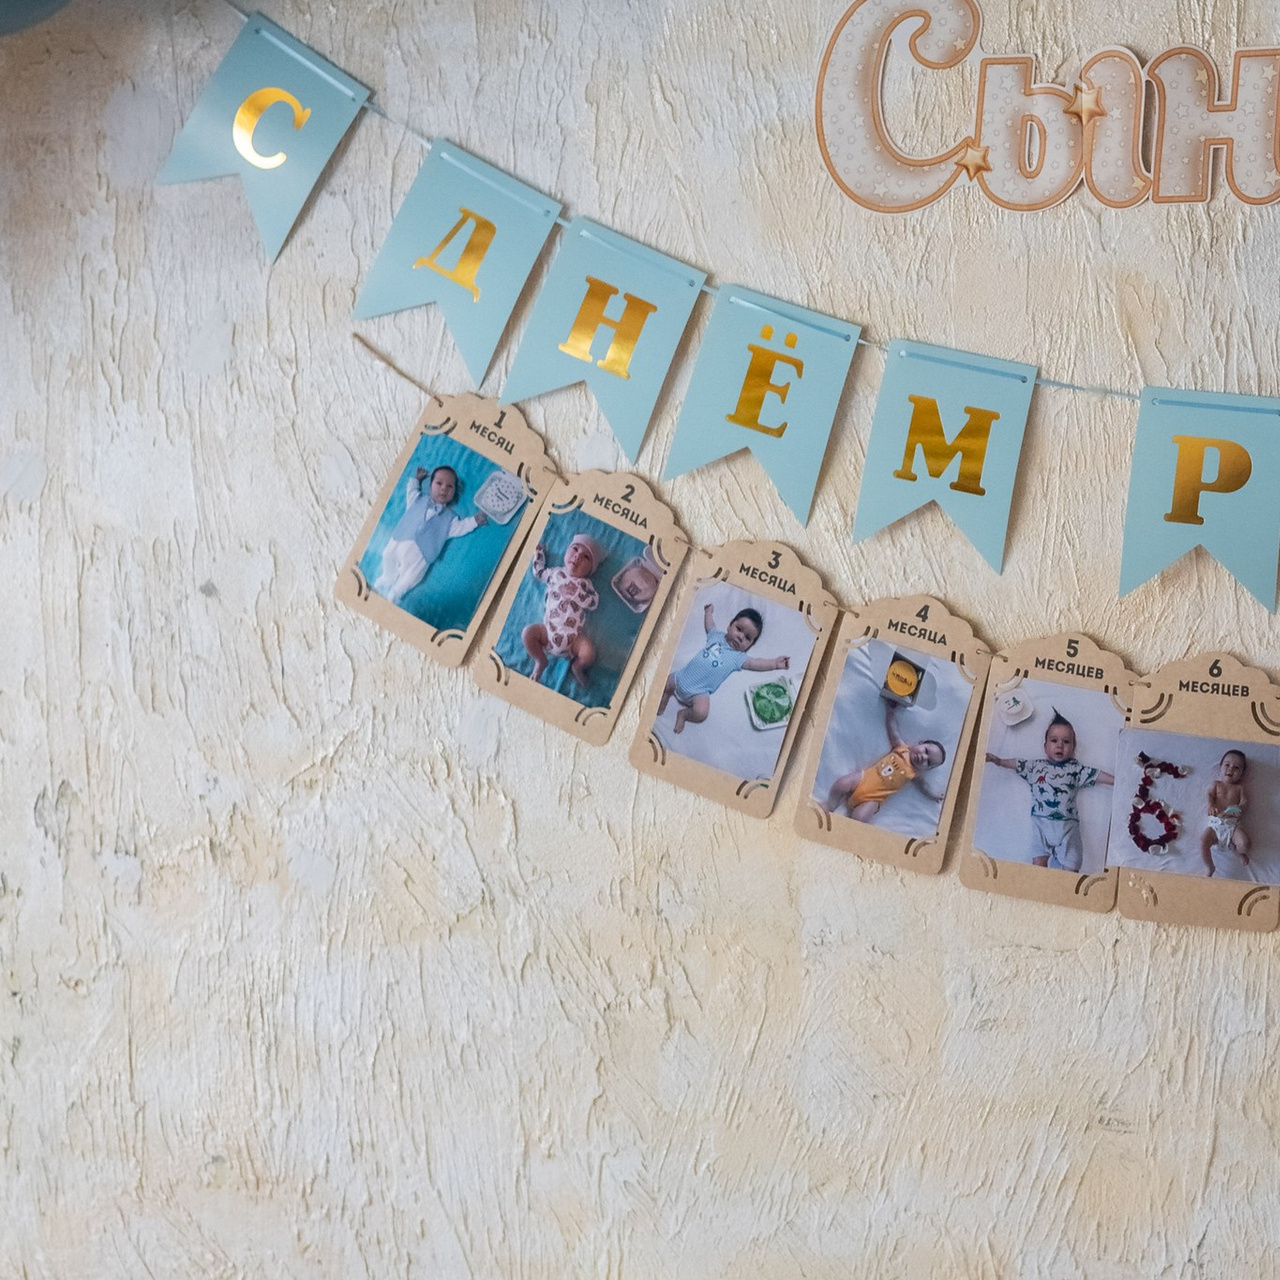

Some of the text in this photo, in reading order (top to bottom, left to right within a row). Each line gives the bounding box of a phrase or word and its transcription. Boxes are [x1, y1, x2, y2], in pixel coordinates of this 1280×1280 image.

[231, 86, 312, 171] С
[412, 206, 1000, 496] ДНЁМ
[493, 410, 507, 429] 1
[469, 419, 515, 455] МЕСЯЦ
[620, 483, 636, 502] 2
[593, 492, 648, 529] МЕСЯЦА
[767, 550, 783, 569] 3
[739, 562, 796, 595] МЕСЯЦА
[915, 604, 930, 623] 4
[888, 618, 947, 646] МЕСЯЦА
[1066, 639, 1080, 657] 5
[1034, 656, 1104, 680] МЕСЯЦЕВ
[1209, 659, 1222, 678] 6
[1179, 679, 1250, 698] МЕСЯЦЕВ
